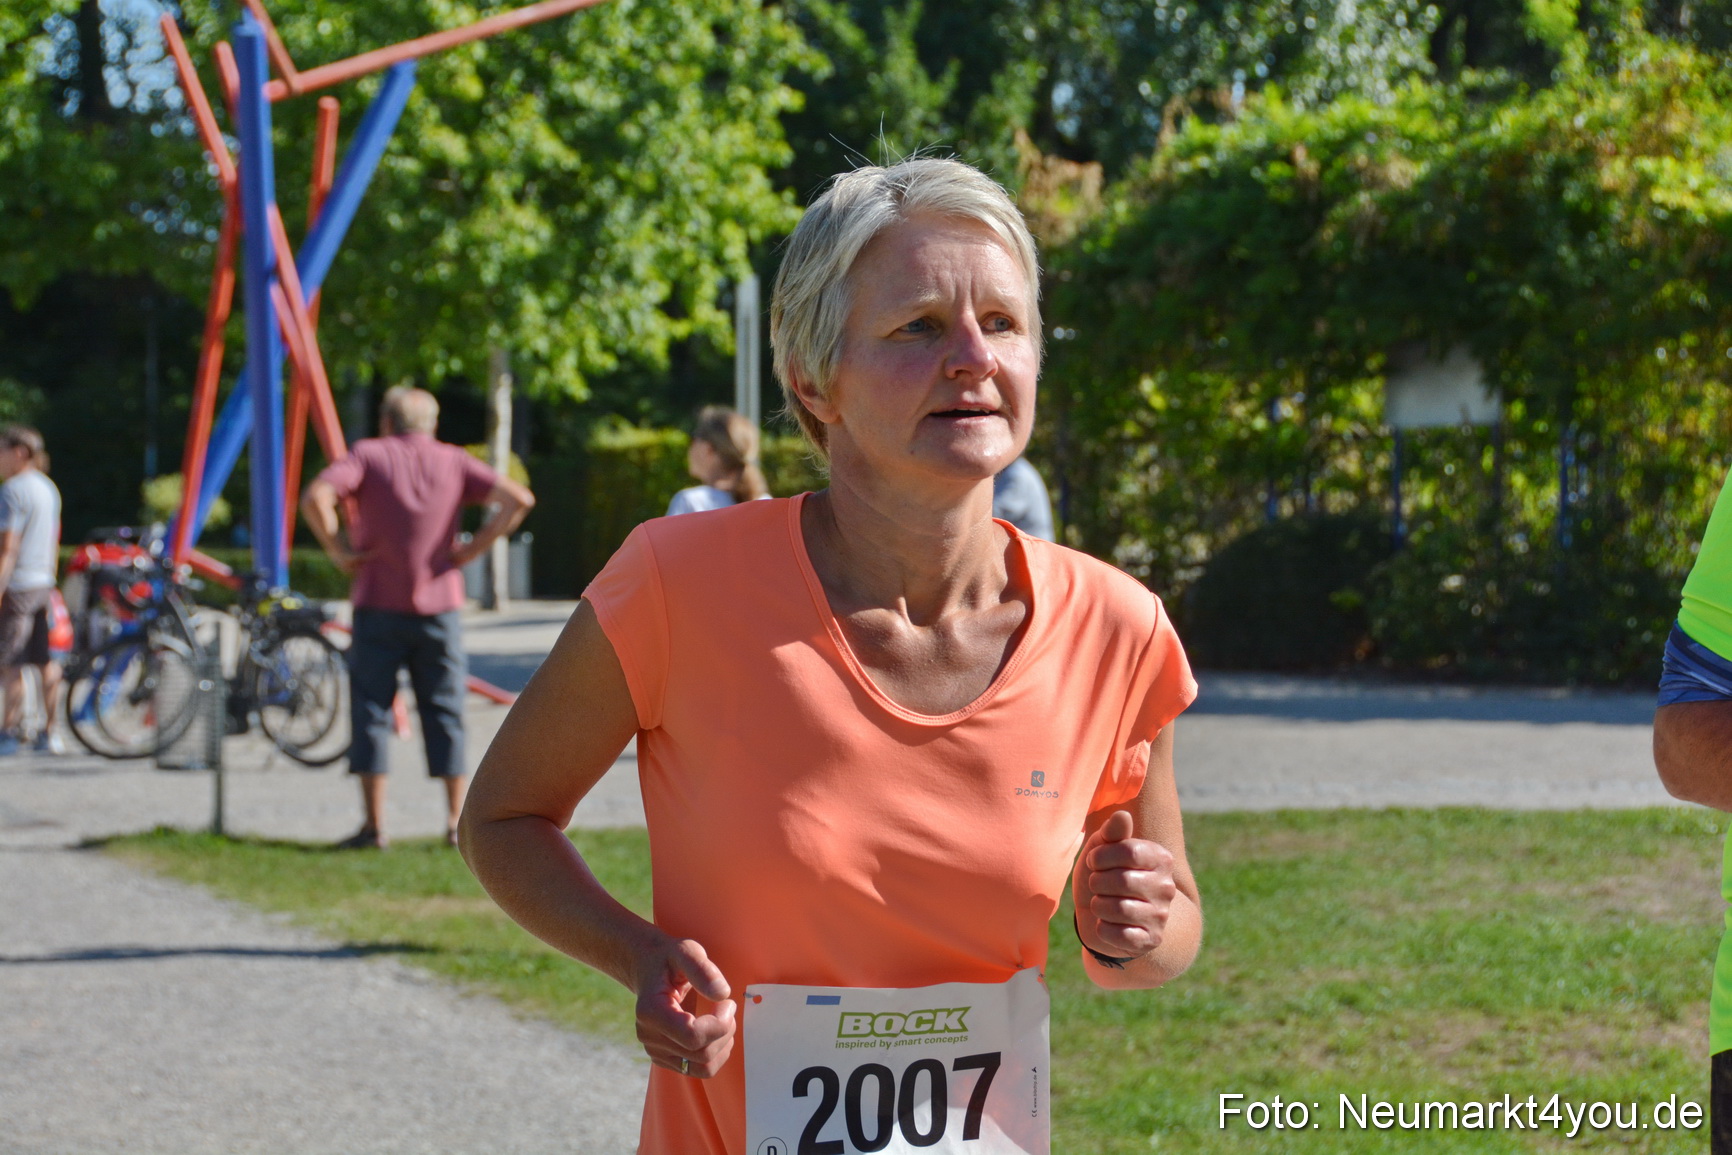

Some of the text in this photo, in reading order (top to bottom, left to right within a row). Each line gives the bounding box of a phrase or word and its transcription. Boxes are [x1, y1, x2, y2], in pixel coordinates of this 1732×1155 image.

[1015, 788, 1059, 798] DOMYOS
[838, 1007, 970, 1037] BOCK
[835, 1035, 969, 1050] inspired by smart concepts
[792, 1052, 1002, 1155] 2007
